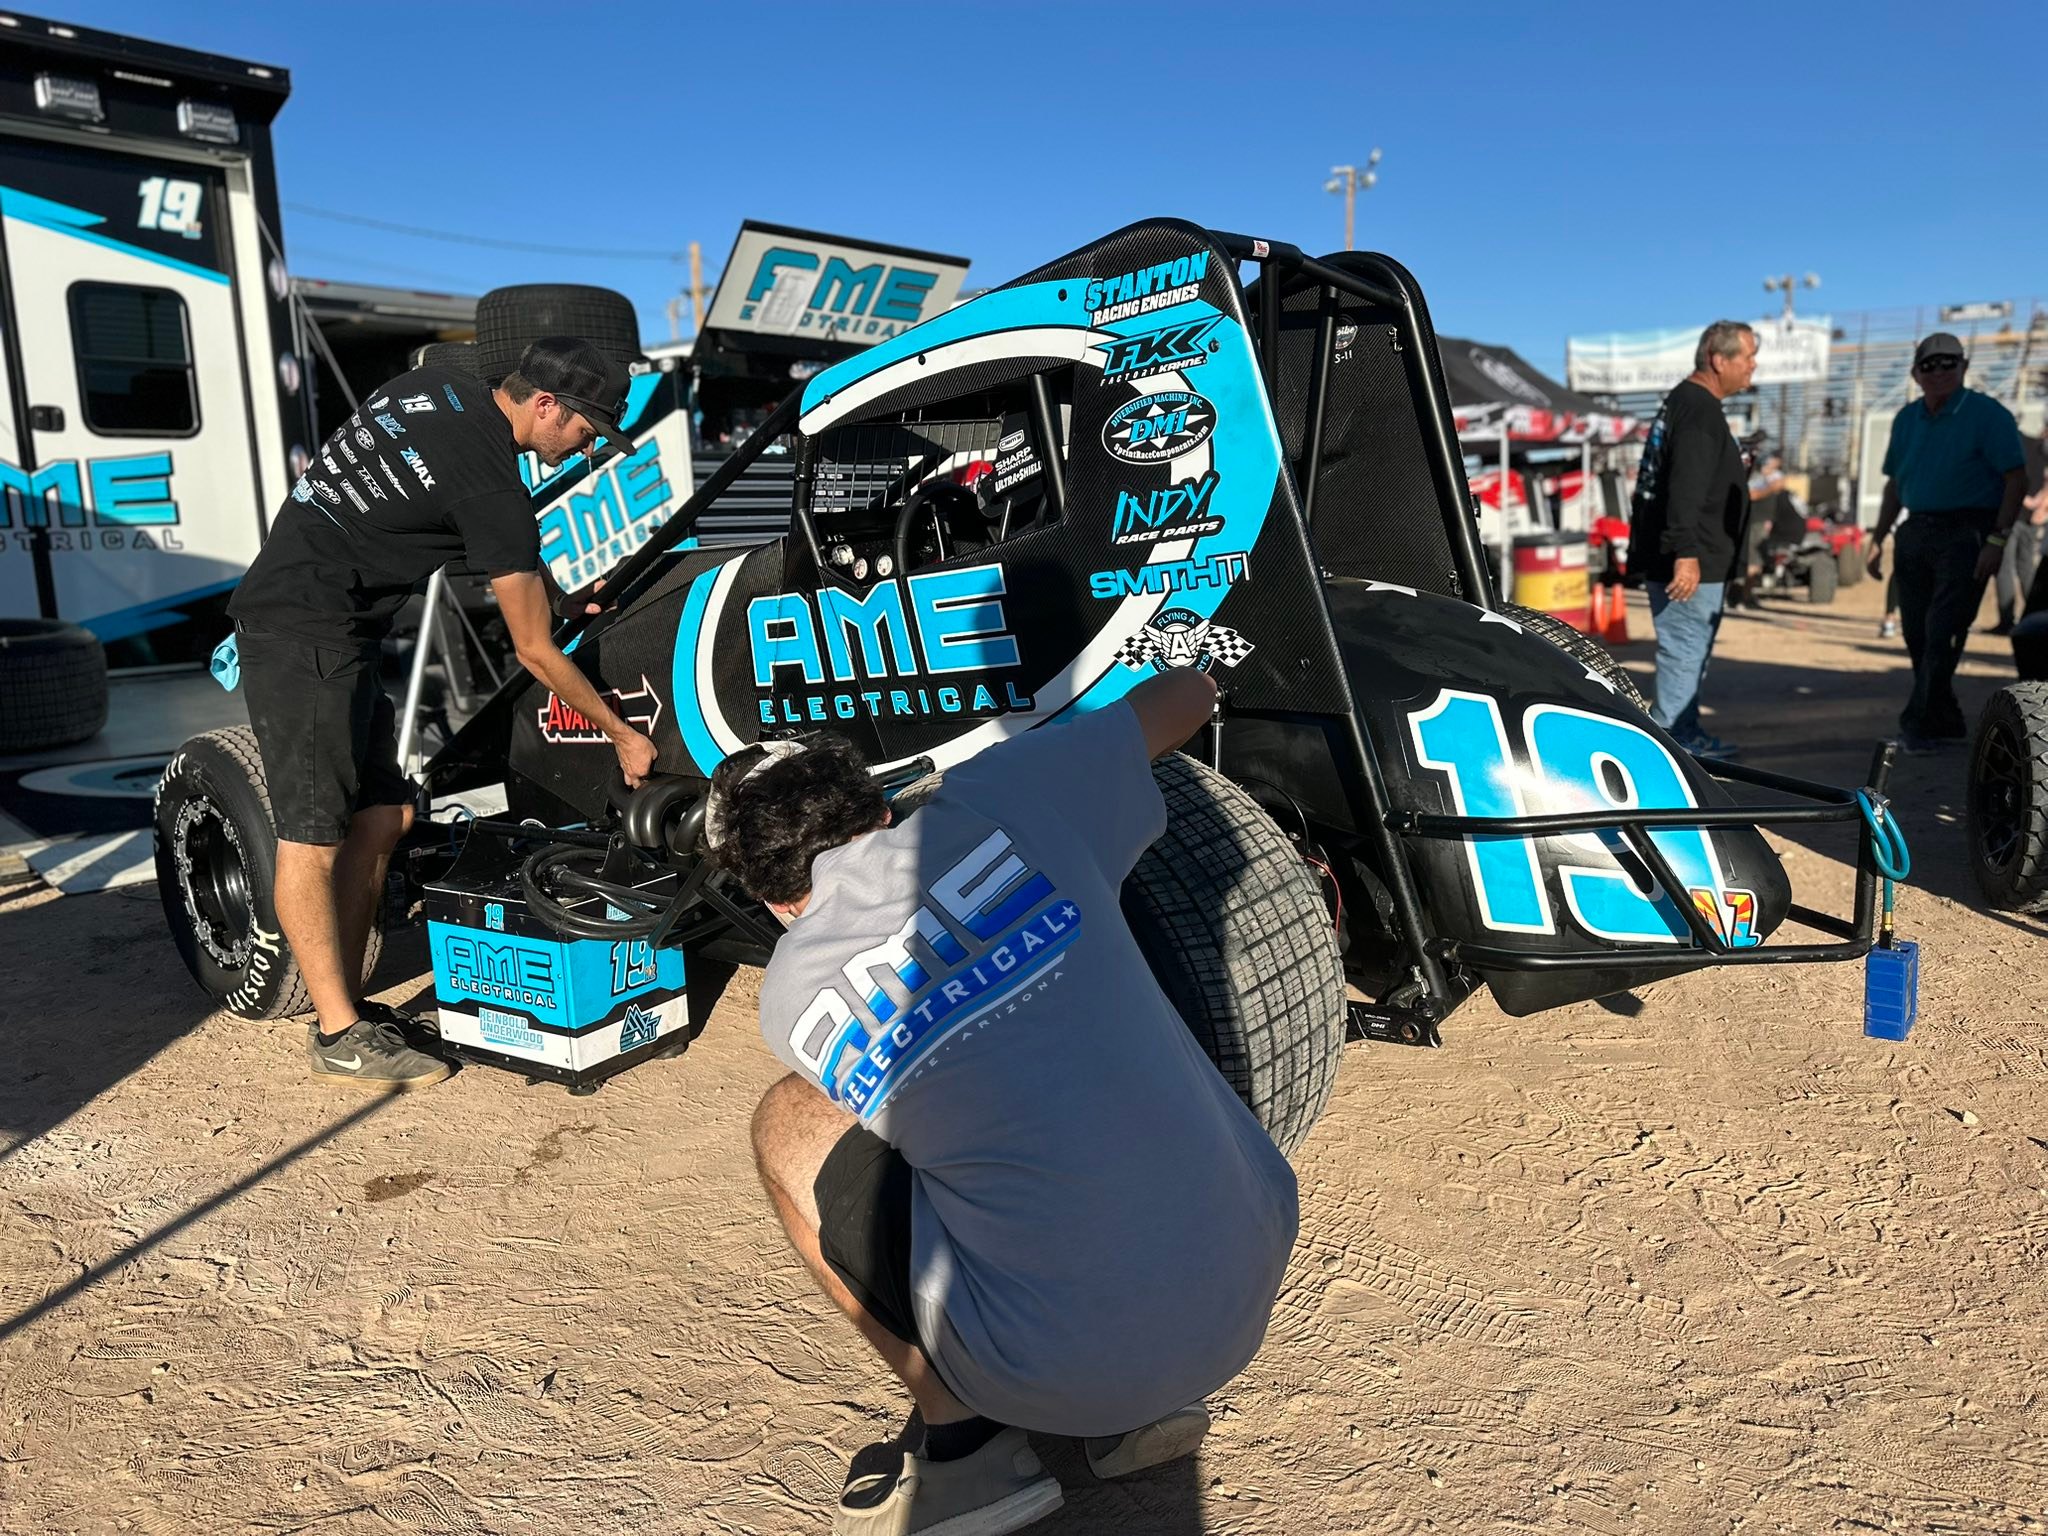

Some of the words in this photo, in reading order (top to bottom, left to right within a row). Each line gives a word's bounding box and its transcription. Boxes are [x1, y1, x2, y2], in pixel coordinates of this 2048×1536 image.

[137, 176, 203, 233] 19
[1086, 250, 1210, 311] STANTON
[1092, 299, 1140, 327] RACING
[1140, 283, 1200, 314] ENGINES
[1100, 366, 1156, 387] FACTORY
[398, 391, 438, 414] 19
[1111, 395, 1154, 428] DIVERSIFIED
[1153, 392, 1189, 404] MACHINE
[1113, 425, 1209, 460] SprintRaceComponents.com
[1128, 409, 1189, 444] DMI
[995, 446, 1031, 472] SHARP
[998, 453, 1034, 476] ADVANTAGE
[1111, 475, 1215, 544] INDY
[1116, 530, 1160, 545] RACE
[1162, 520, 1221, 538] PARTS
[747, 562, 1022, 687] AME
[1156, 611, 1188, 628] FLYING
[1188, 615, 1196, 625] A
[1170, 632, 1193, 660] A
[758, 681, 1031, 724] ELECTRICAL
[1407, 687, 1712, 944] 19
[484, 902, 504, 930] 19
[445, 935, 555, 994] AME
[610, 938, 656, 998] 19
[788, 826, 1057, 1101] AME
[451, 976, 557, 1009] ELECTRICAL
[962, 970, 1064, 1042] ARIZONA
[479, 1009, 527, 1031] REINBOLD
[848, 914, 1066, 1107] ELECTRICAL
[479, 1020, 544, 1045] UNDERWOOD
